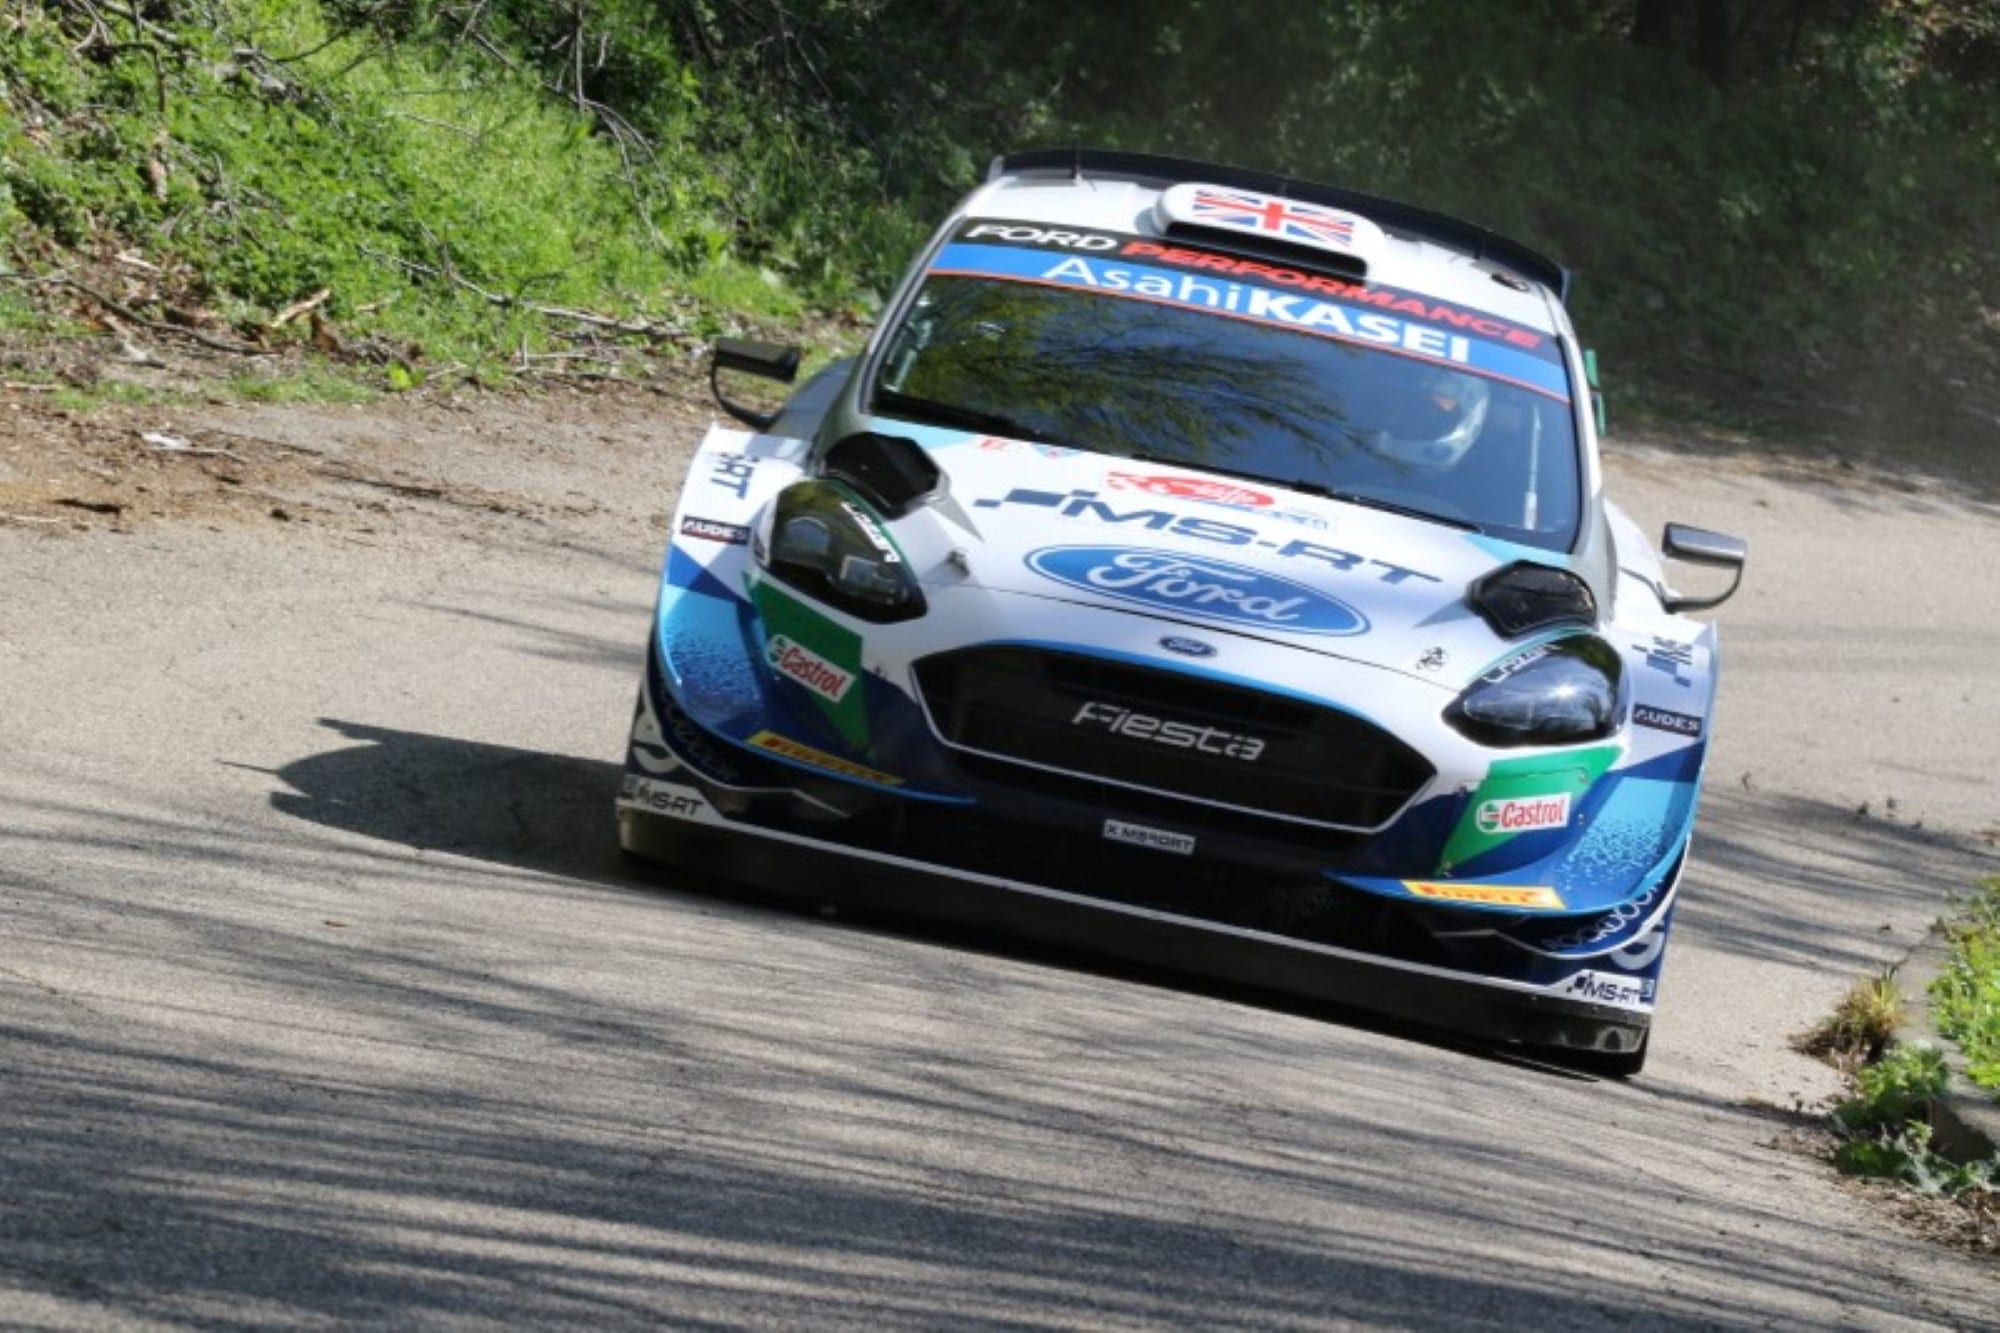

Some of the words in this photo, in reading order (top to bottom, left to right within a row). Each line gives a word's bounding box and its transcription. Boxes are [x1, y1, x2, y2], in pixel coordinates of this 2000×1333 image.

[964, 223, 1118, 251] FORD
[1121, 240, 1542, 348] PERFORMANCE
[1087, 549, 1308, 622] Ford
[782, 646, 847, 697] Castrol
[1072, 701, 1266, 761] Fiesta
[1501, 799, 1566, 828] Castrol
